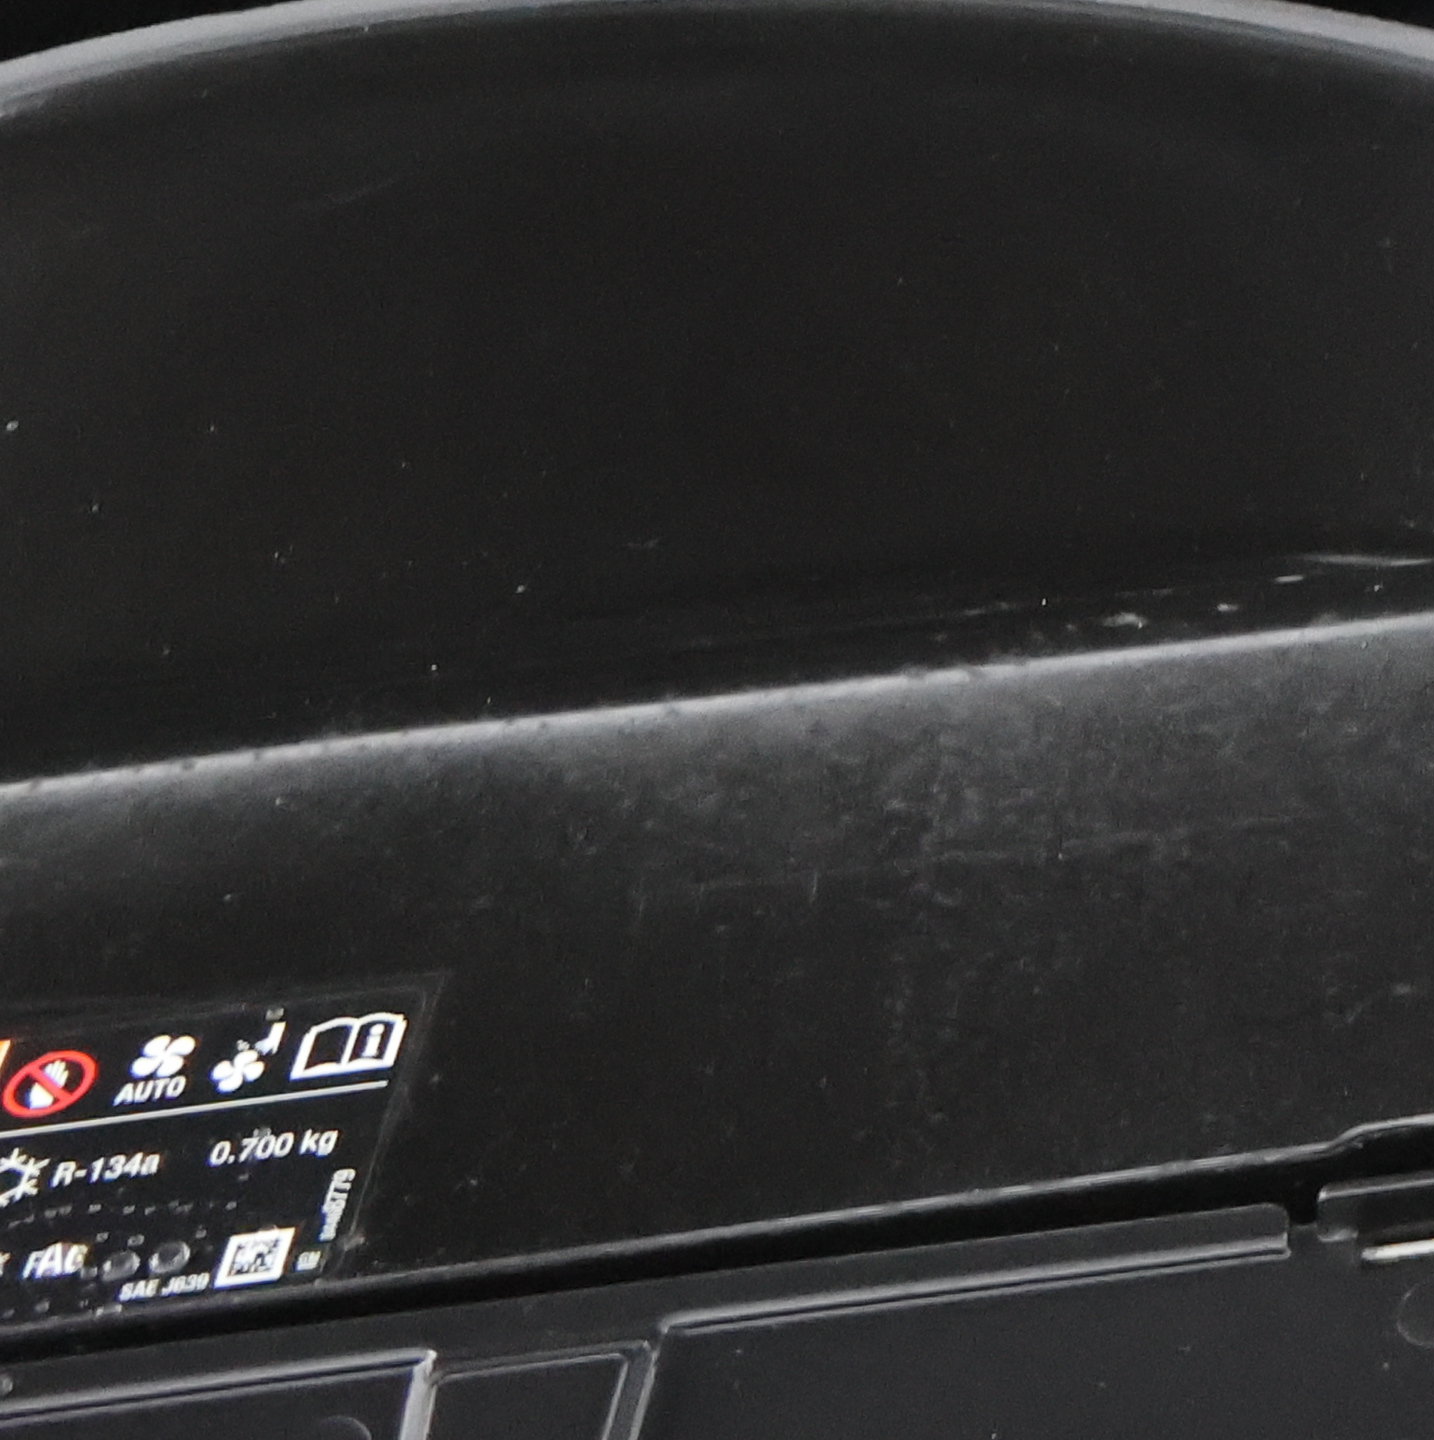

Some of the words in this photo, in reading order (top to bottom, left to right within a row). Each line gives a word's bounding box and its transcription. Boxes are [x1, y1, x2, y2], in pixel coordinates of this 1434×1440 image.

[113, 1075, 187, 1106] AUTO
[51, 1152, 161, 1188] R-134a
[208, 1131, 295, 1167] 0.700
[299, 1128, 339, 1158] kg
